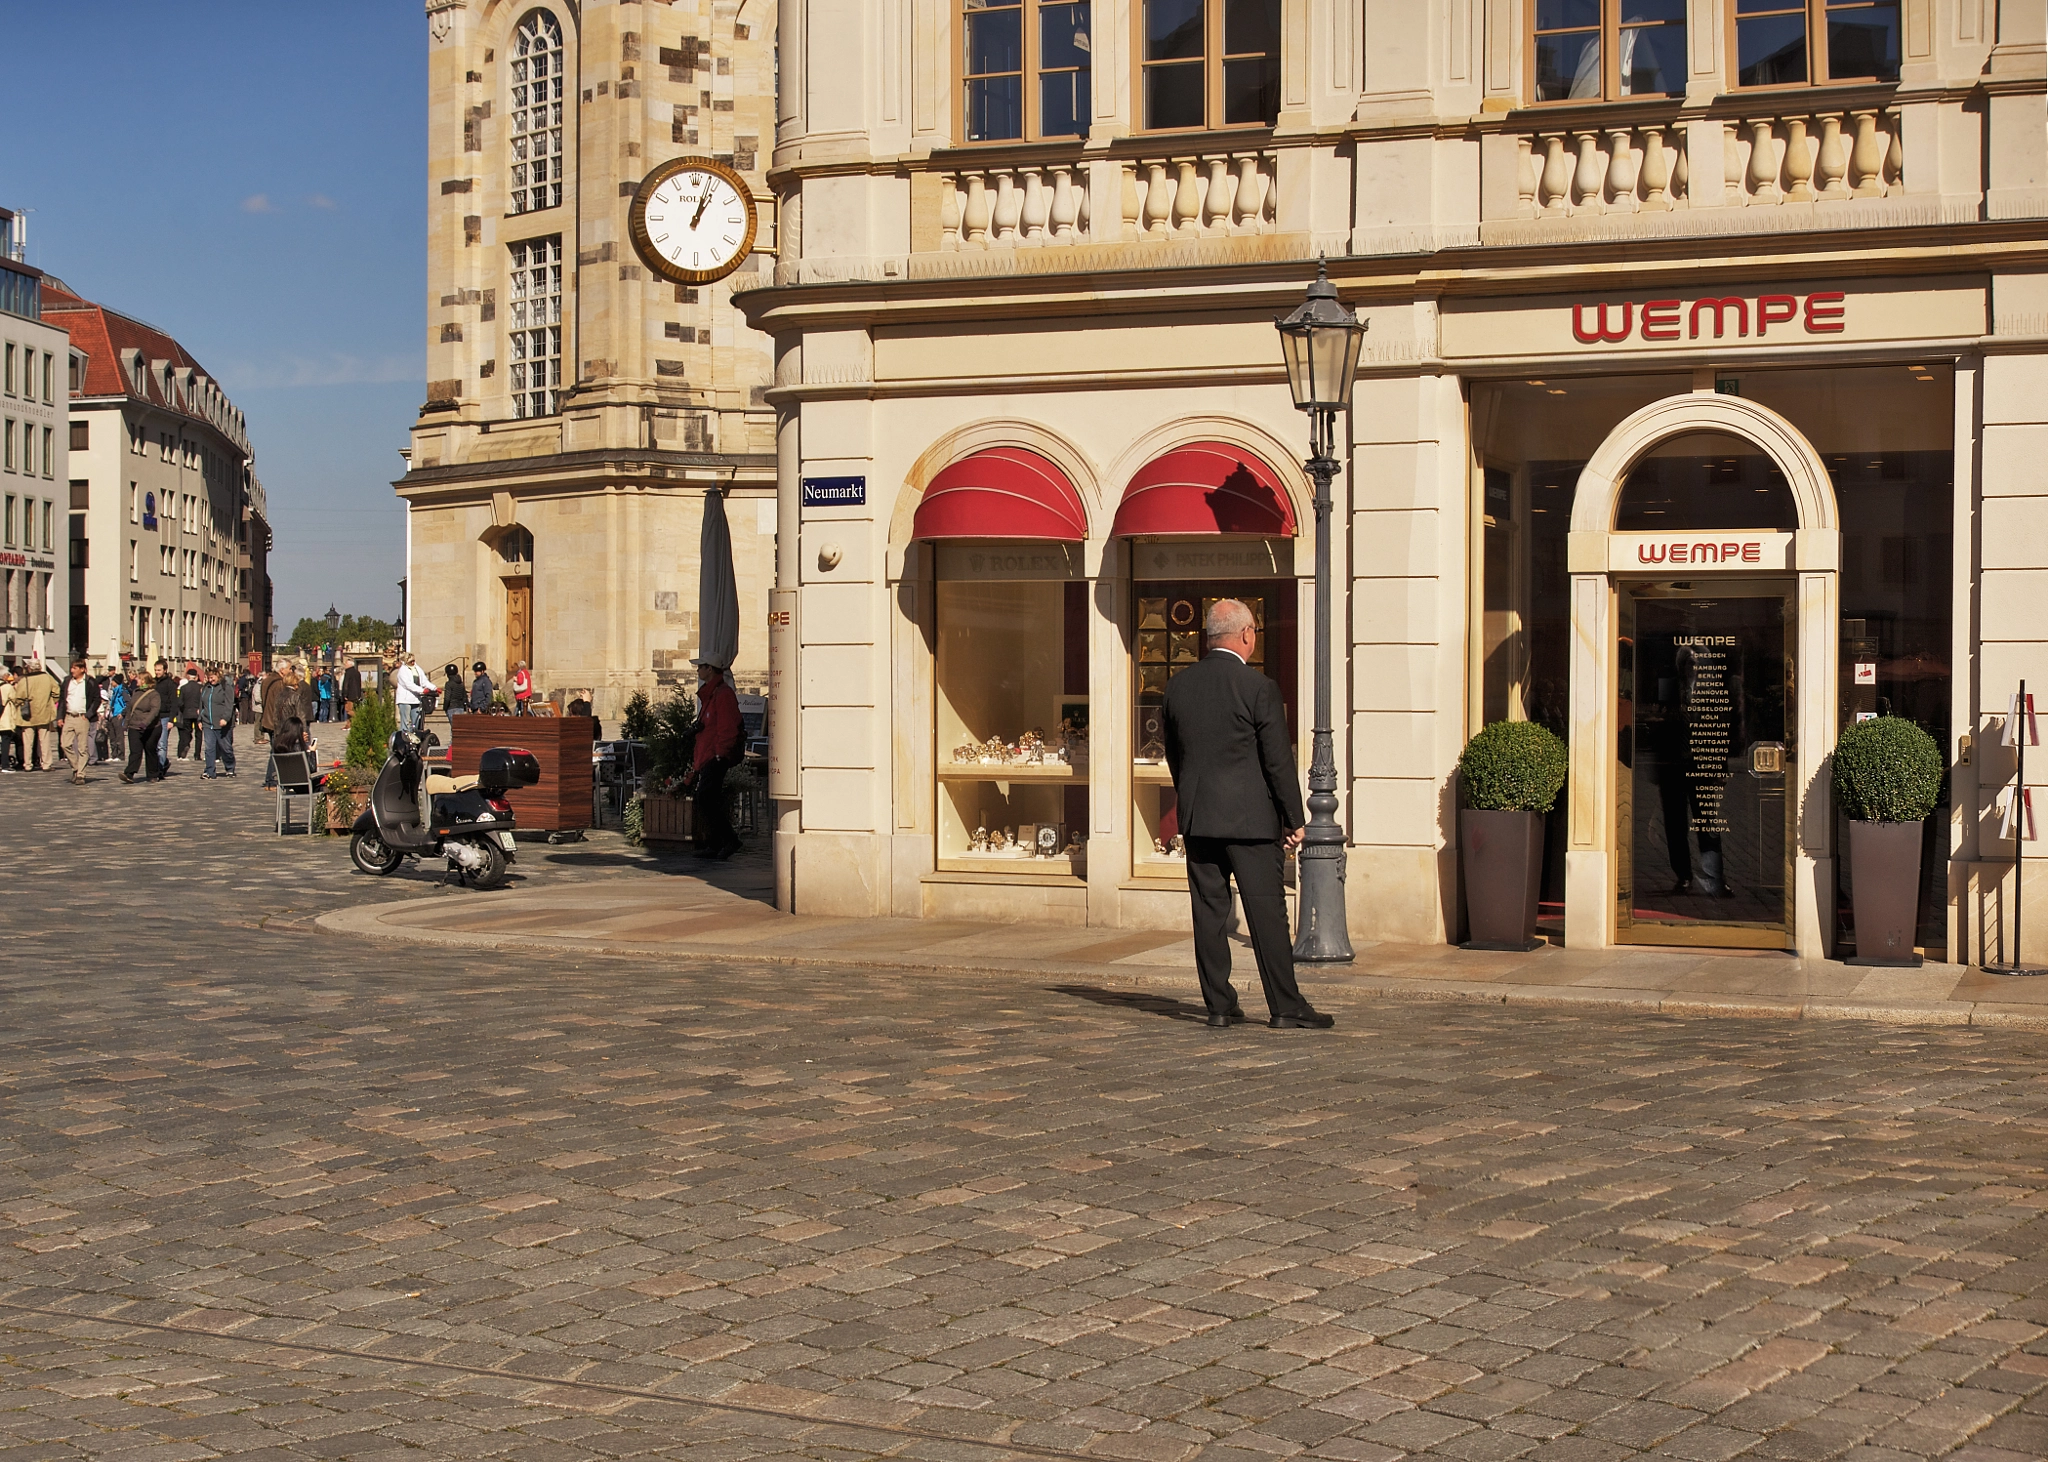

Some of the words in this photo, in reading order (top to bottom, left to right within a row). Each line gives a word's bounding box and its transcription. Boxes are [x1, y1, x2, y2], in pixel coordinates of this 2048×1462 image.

[1572, 291, 1846, 344] WEMPE
[804, 483, 864, 499] Neumarkt
[1176, 552, 1216, 567] PATEK
[1638, 541, 1762, 564] WEMPE
[514, 564, 521, 575] C
[990, 554, 1060, 571] ROLEX
[1673, 635, 1736, 646] WEMPE
